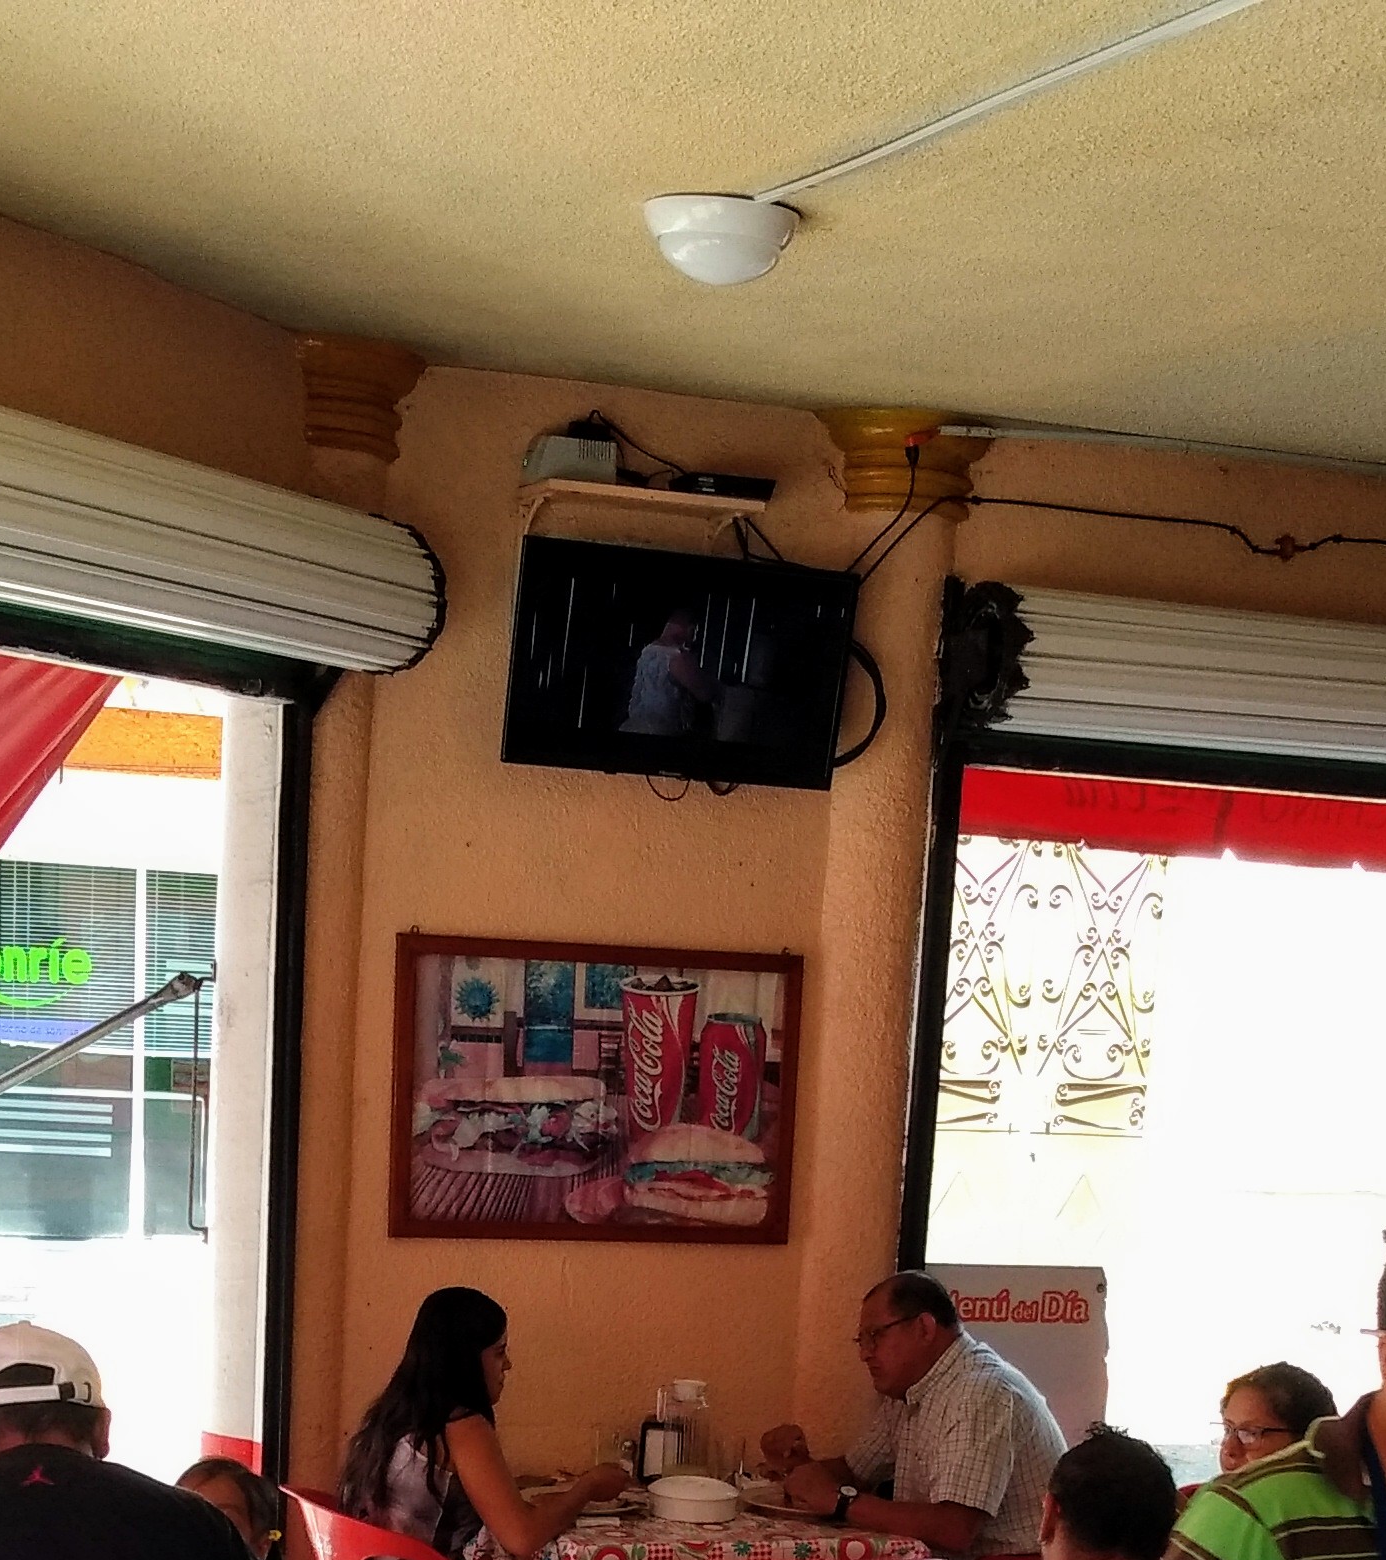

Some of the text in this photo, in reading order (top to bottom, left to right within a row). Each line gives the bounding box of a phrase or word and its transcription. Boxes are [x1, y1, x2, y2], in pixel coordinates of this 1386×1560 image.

[627, 997, 664, 1132] Coca-Cola
[1012, 1301, 1038, 1323] del
[1041, 1290, 1091, 1323] Día
